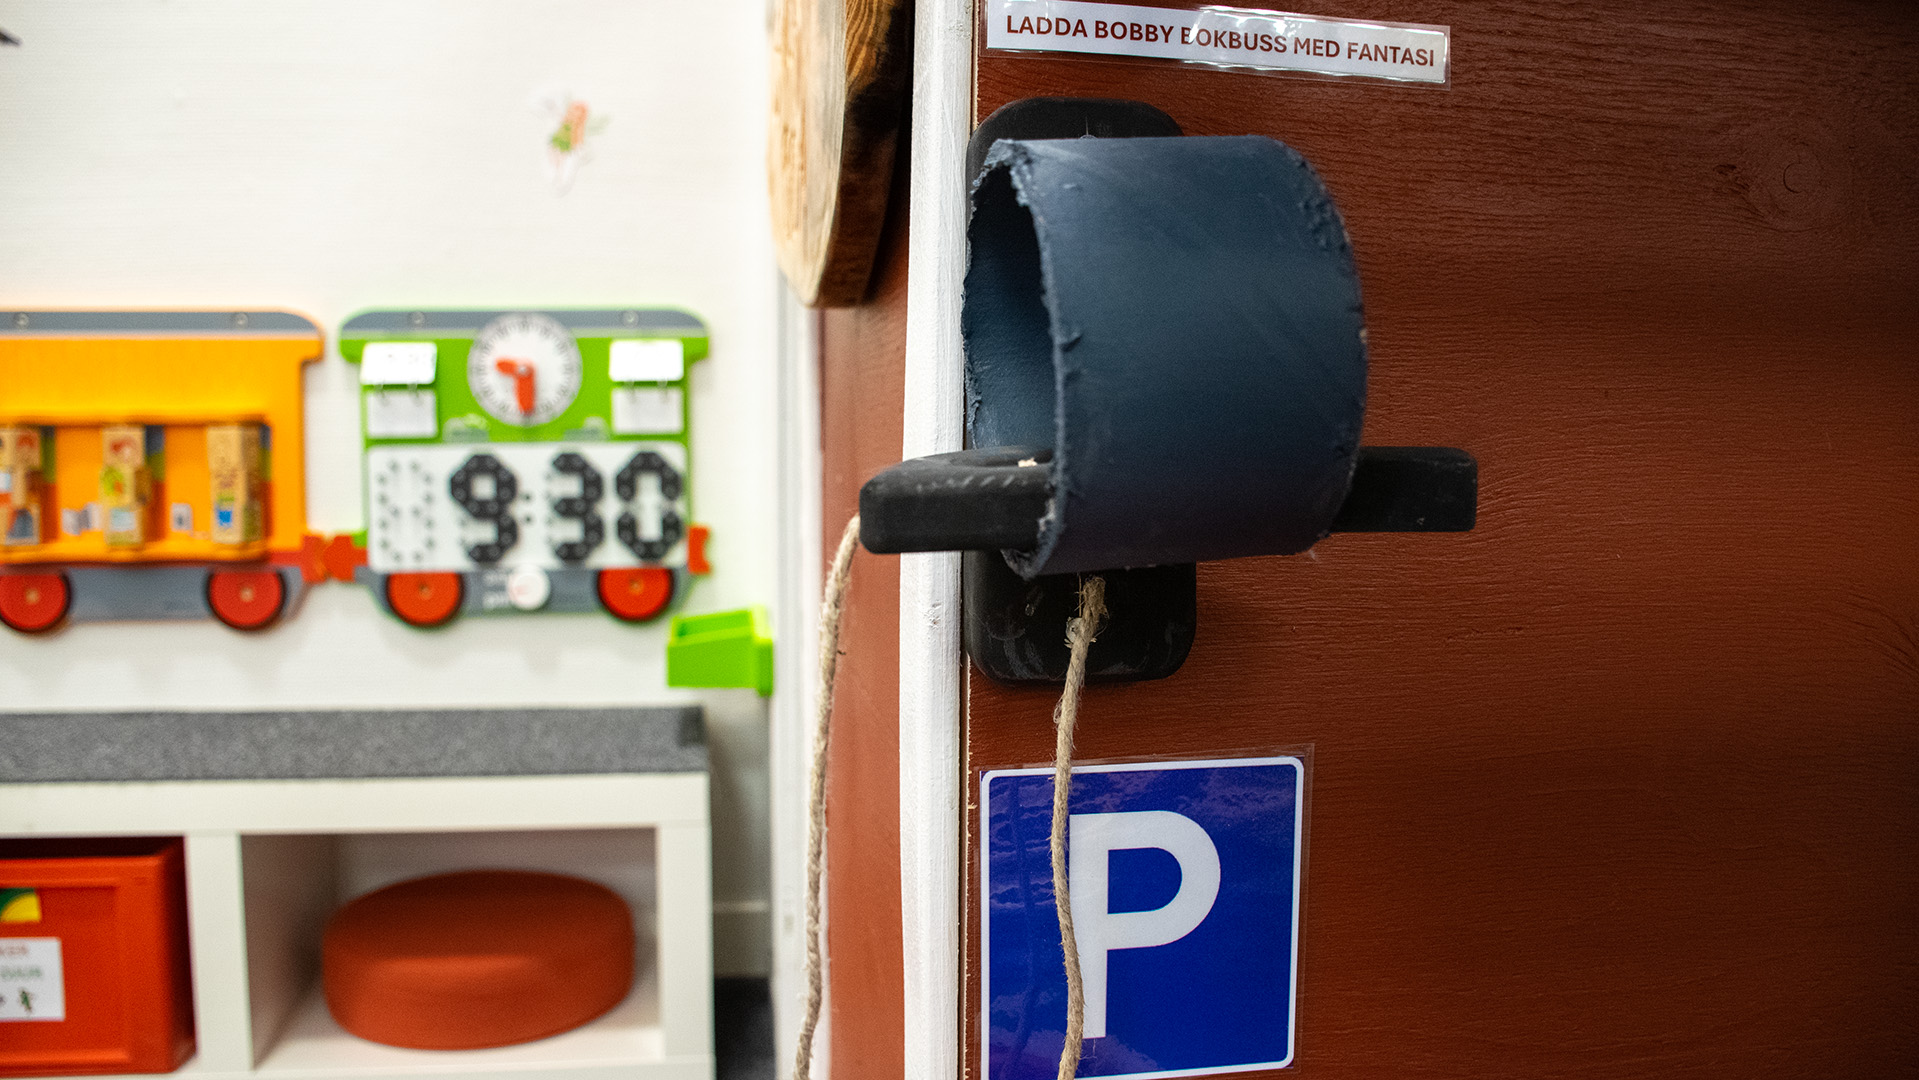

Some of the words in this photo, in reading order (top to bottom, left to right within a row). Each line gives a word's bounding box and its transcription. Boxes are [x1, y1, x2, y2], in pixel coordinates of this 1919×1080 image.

[1006, 15, 1088, 38] LADDA
[1094, 20, 1174, 44] BOBBY
[1181, 27, 1287, 53] BOKBUSS
[1293, 37, 1340, 58] MED
[1347, 43, 1435, 67] FANTASI
[1070, 811, 1221, 1039] P
